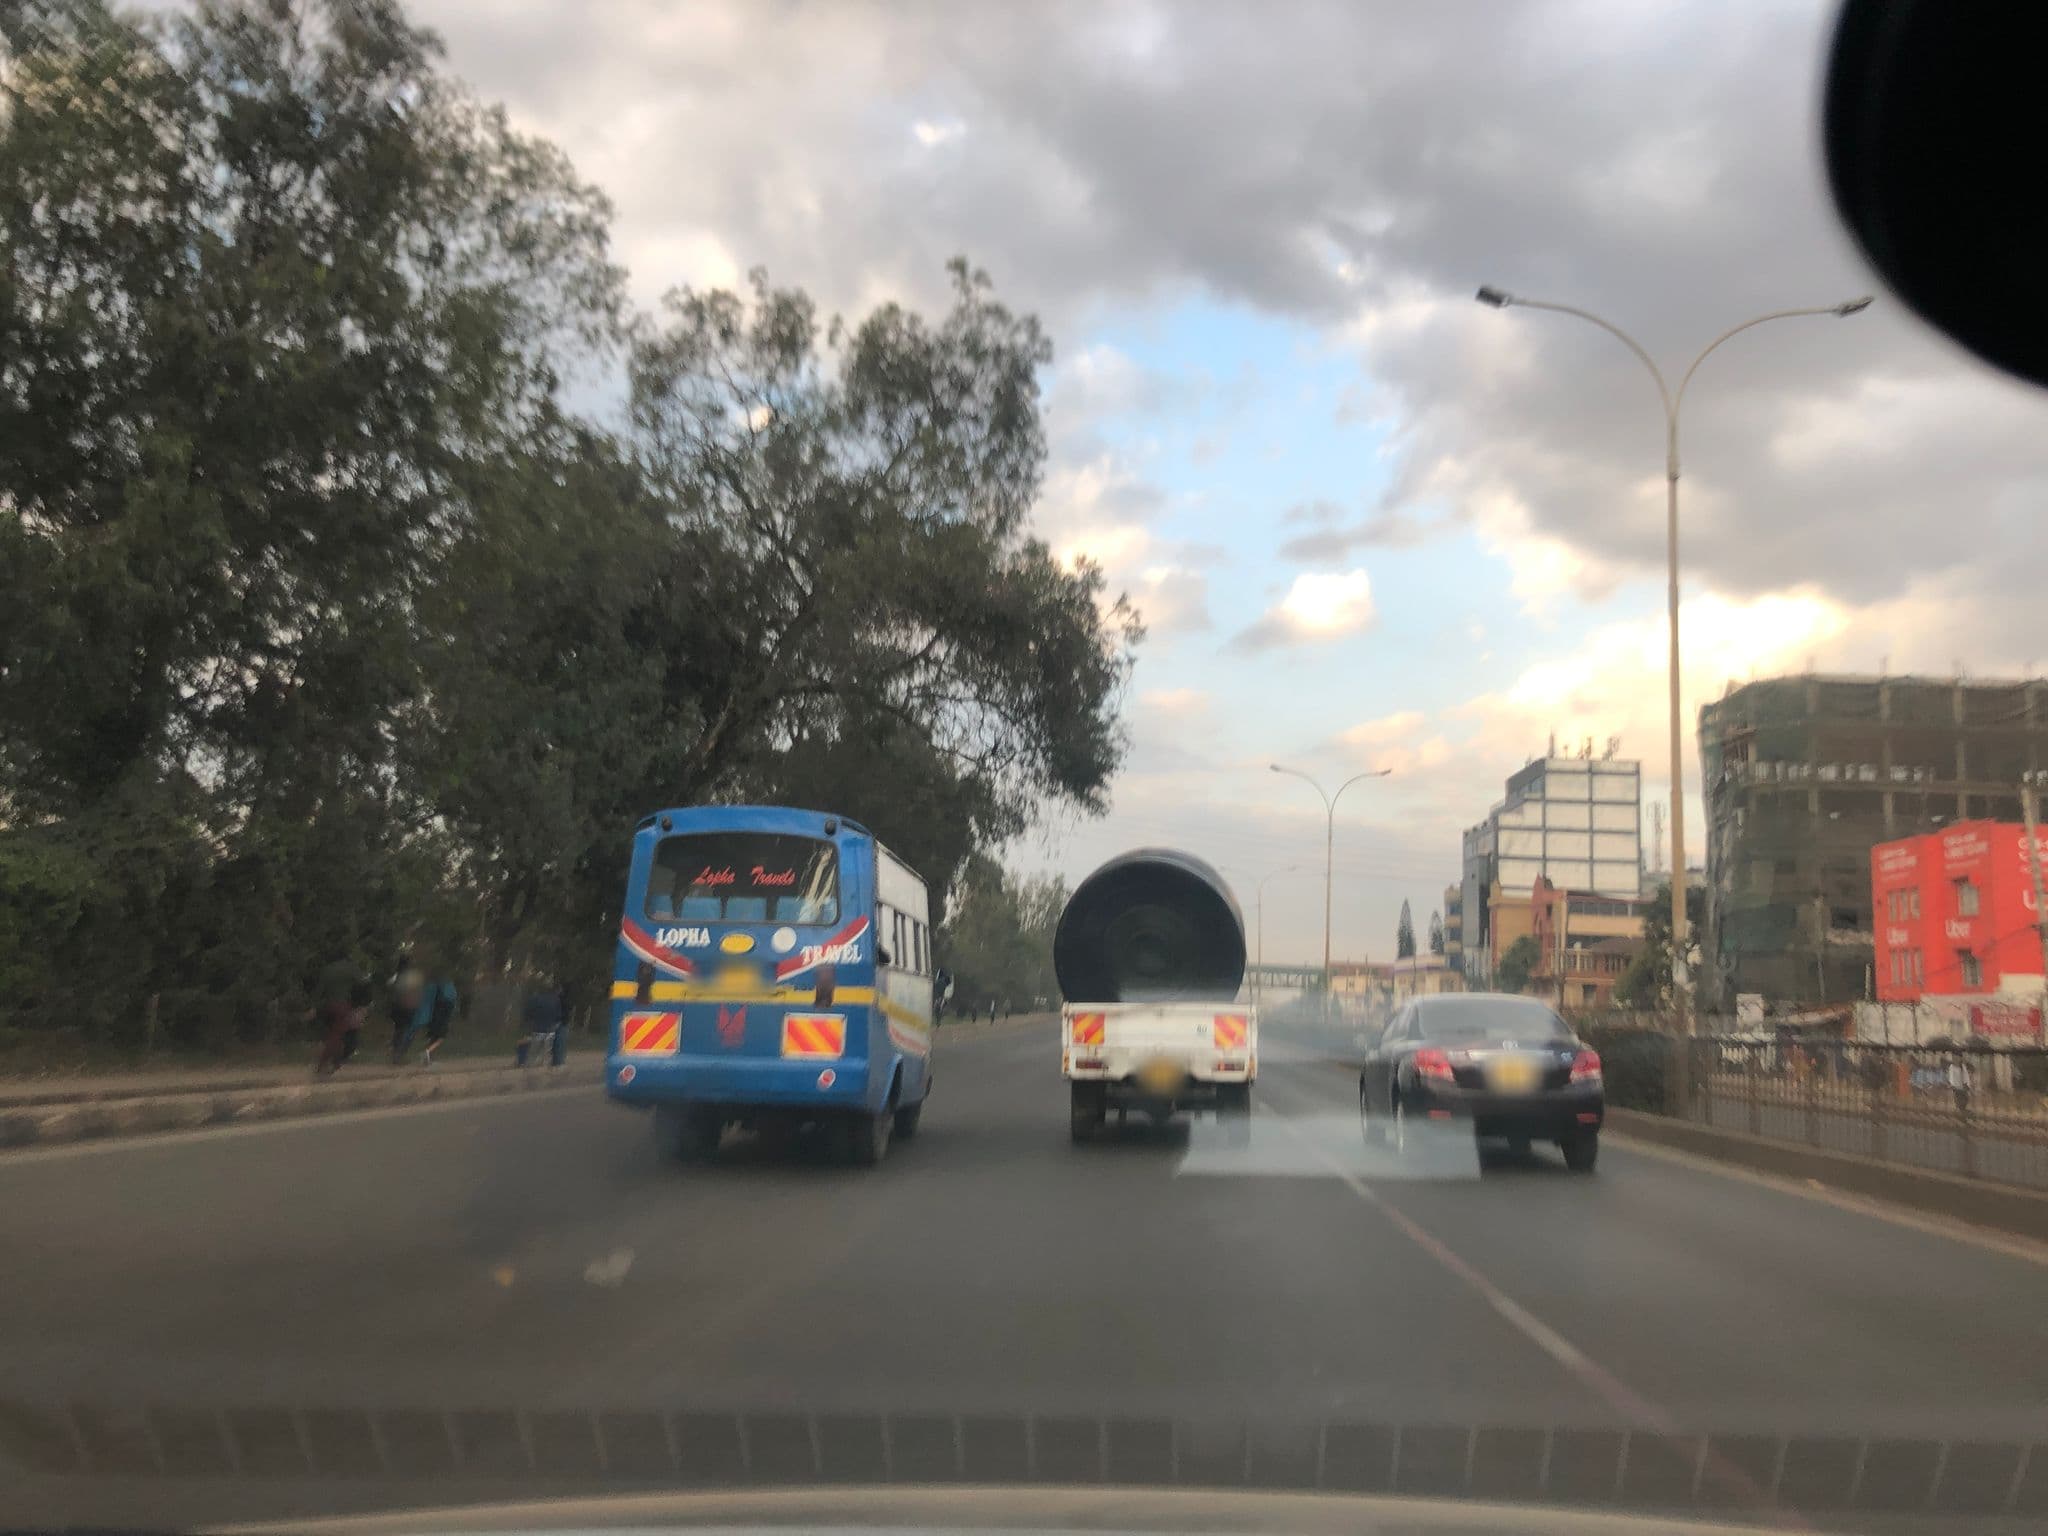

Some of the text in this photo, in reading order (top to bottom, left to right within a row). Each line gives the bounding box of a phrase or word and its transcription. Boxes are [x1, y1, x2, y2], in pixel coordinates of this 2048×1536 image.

[693, 864, 796, 888] Lopha Travels
[656, 927, 711, 946] LOPHA
[801, 944, 863, 965] TRAVEL
